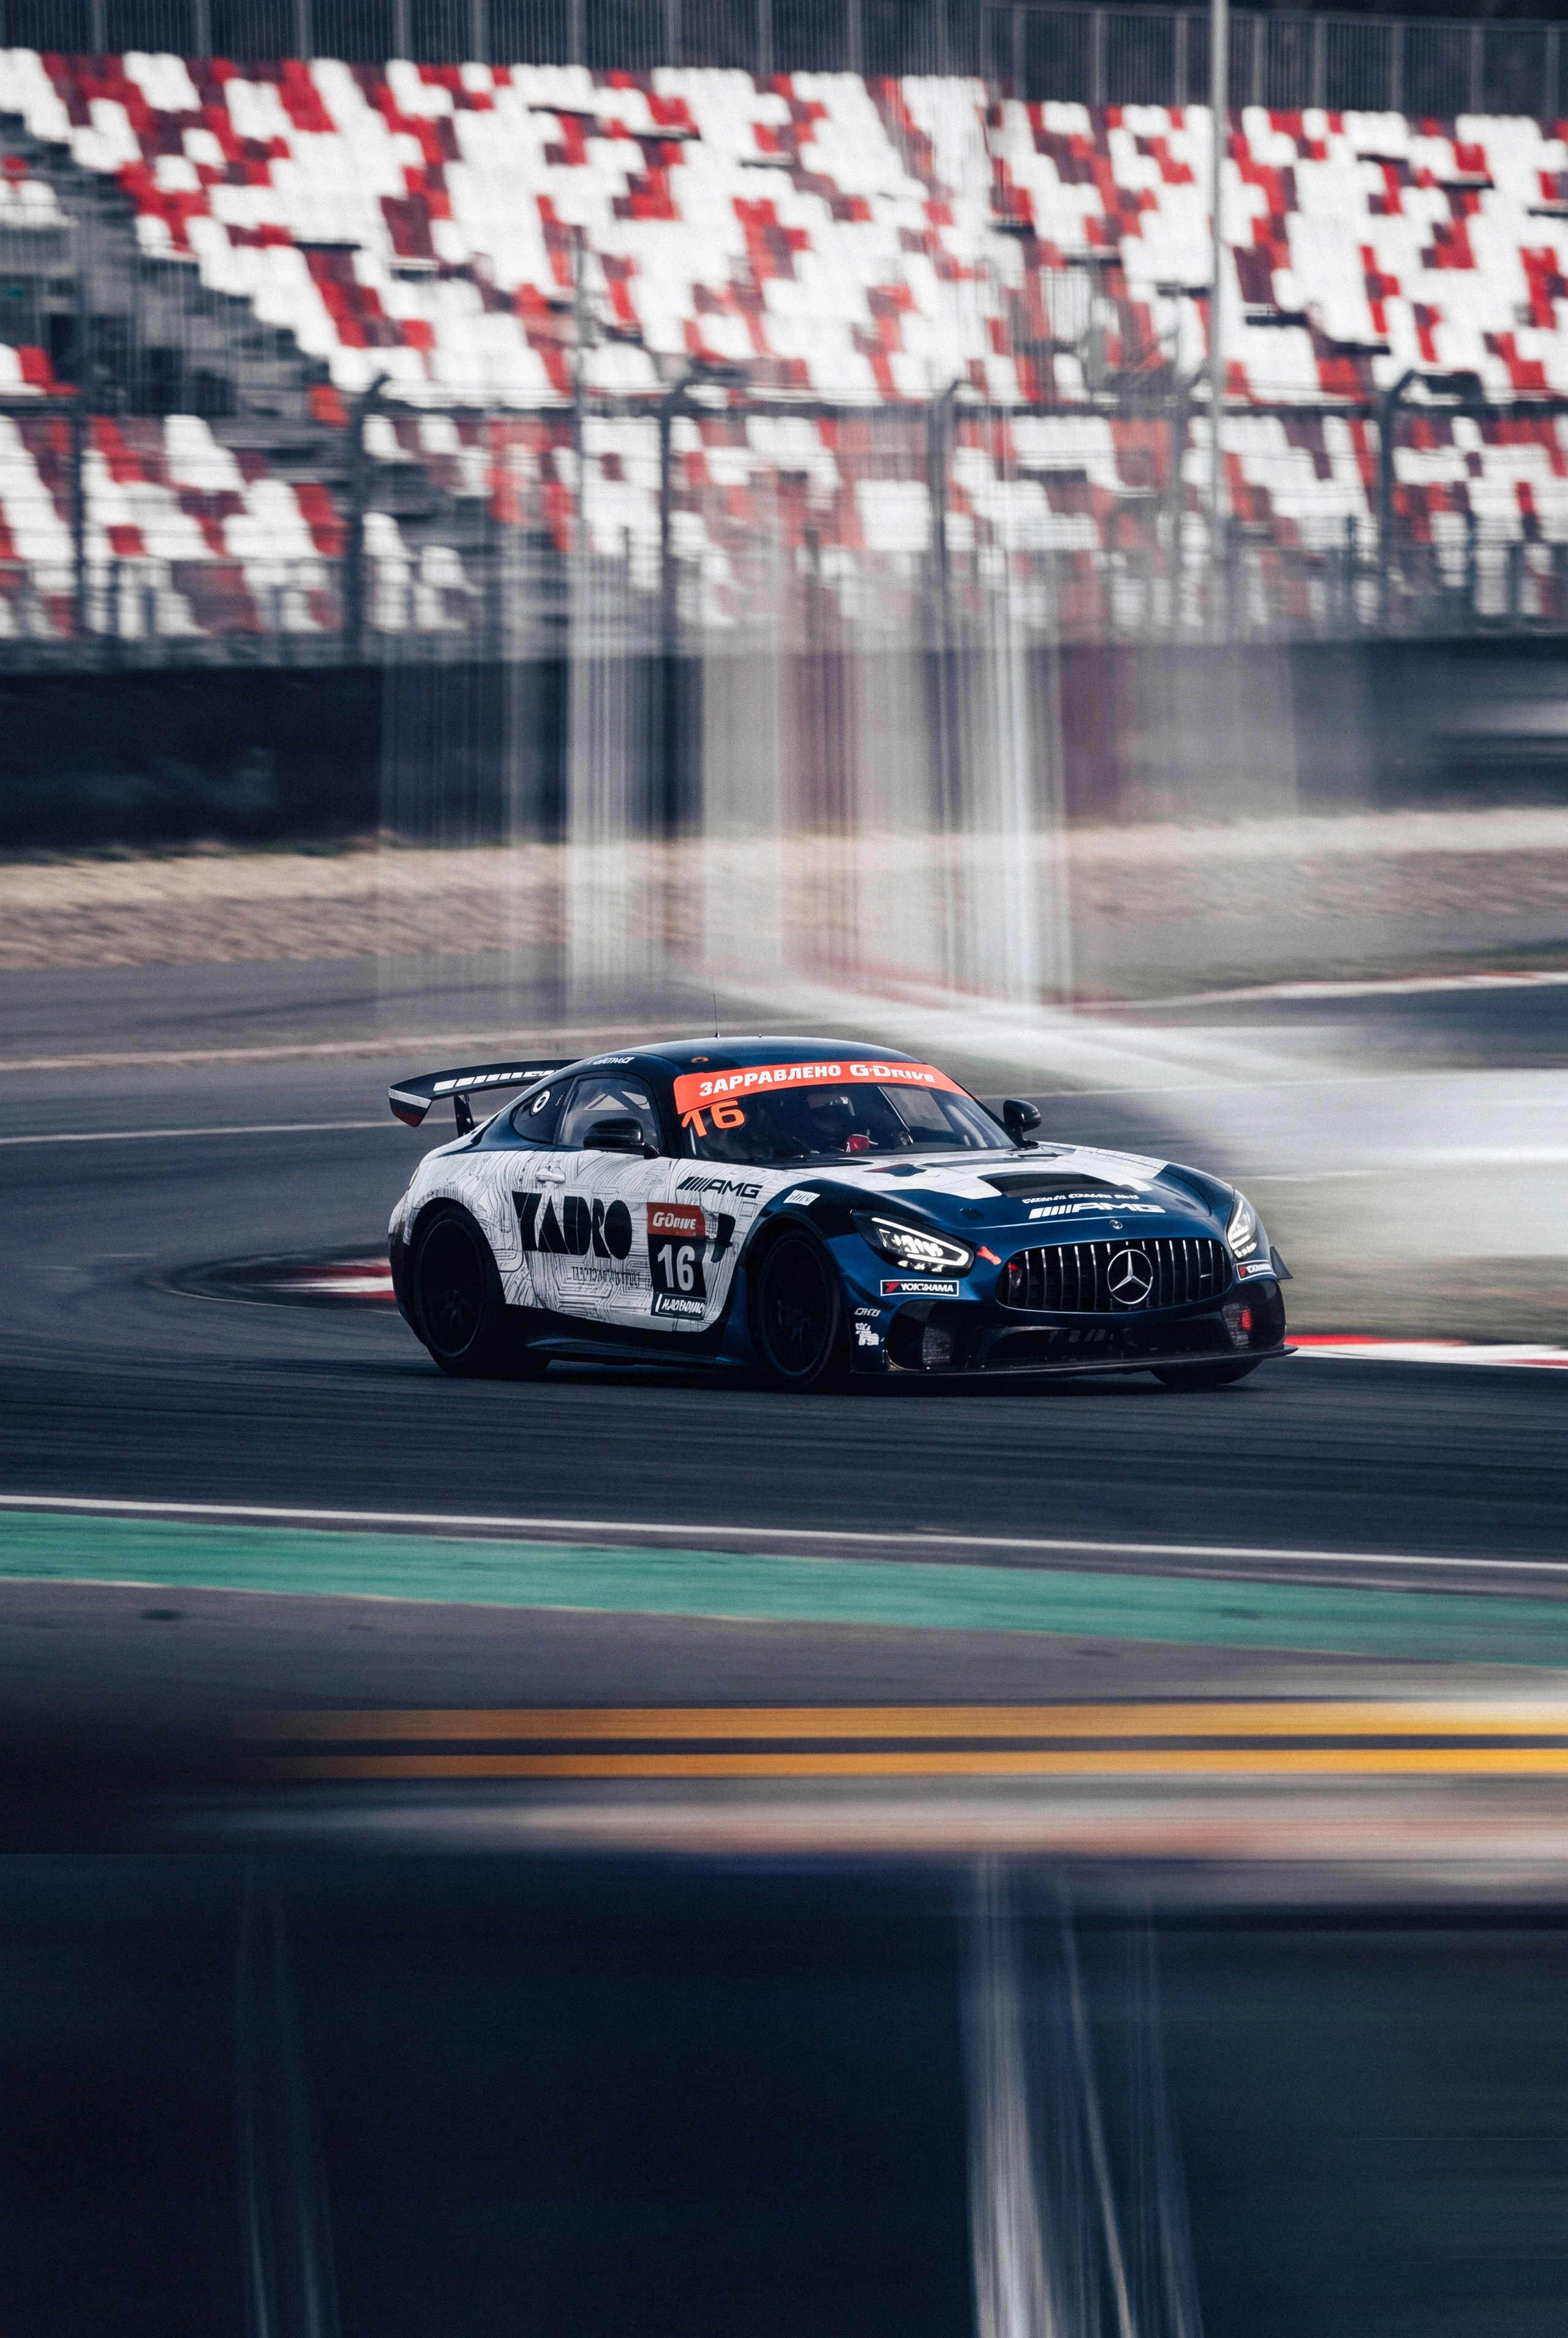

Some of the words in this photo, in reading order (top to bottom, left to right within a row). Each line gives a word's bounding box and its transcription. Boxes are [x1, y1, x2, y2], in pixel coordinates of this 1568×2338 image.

[681, 1100, 745, 1137] 16
[703, 1179, 764, 1199] AMG
[657, 1244, 695, 1292] 16
